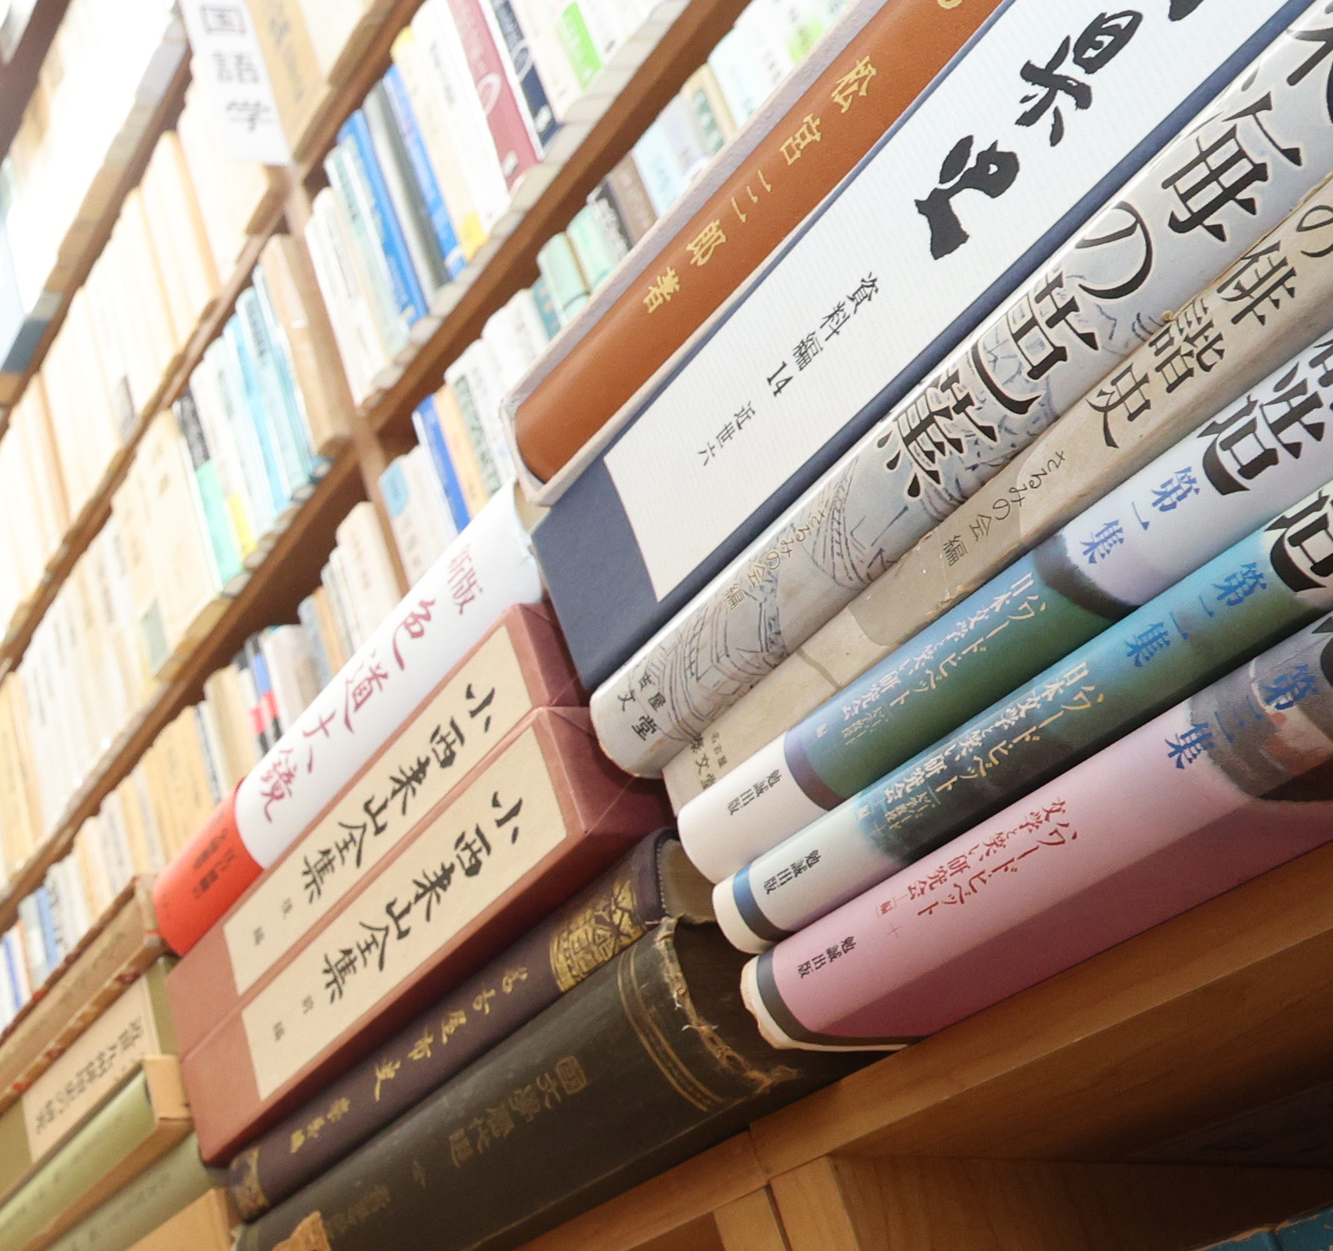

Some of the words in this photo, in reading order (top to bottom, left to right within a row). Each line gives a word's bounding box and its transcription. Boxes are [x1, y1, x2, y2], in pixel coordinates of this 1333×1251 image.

[201, 5, 273, 132] 国語学
[916, 0, 1205, 260] 県史
[643, 56, 878, 313] 松宮三郎著
[697, 401, 756, 468] 近世六
[971, 449, 1069, 541] さるみの会
[1080, 466, 1203, 564] 第一集
[445, 543, 486, 615] 新版
[941, 534, 969, 567] 編
[1124, 562, 1268, 667] 第二集
[259, 598, 439, 826] 色道大鏡
[883, 662, 1090, 807] 日本文学と笑い研究会
[1165, 662, 1321, 772] 第三集
[725, 767, 783, 817] 勉誠出版
[763, 846, 822, 897] 勉誠出版
[902, 797, 1068, 903] 文学と笑い研究会
[794, 933, 858, 981] 勉誠出版
